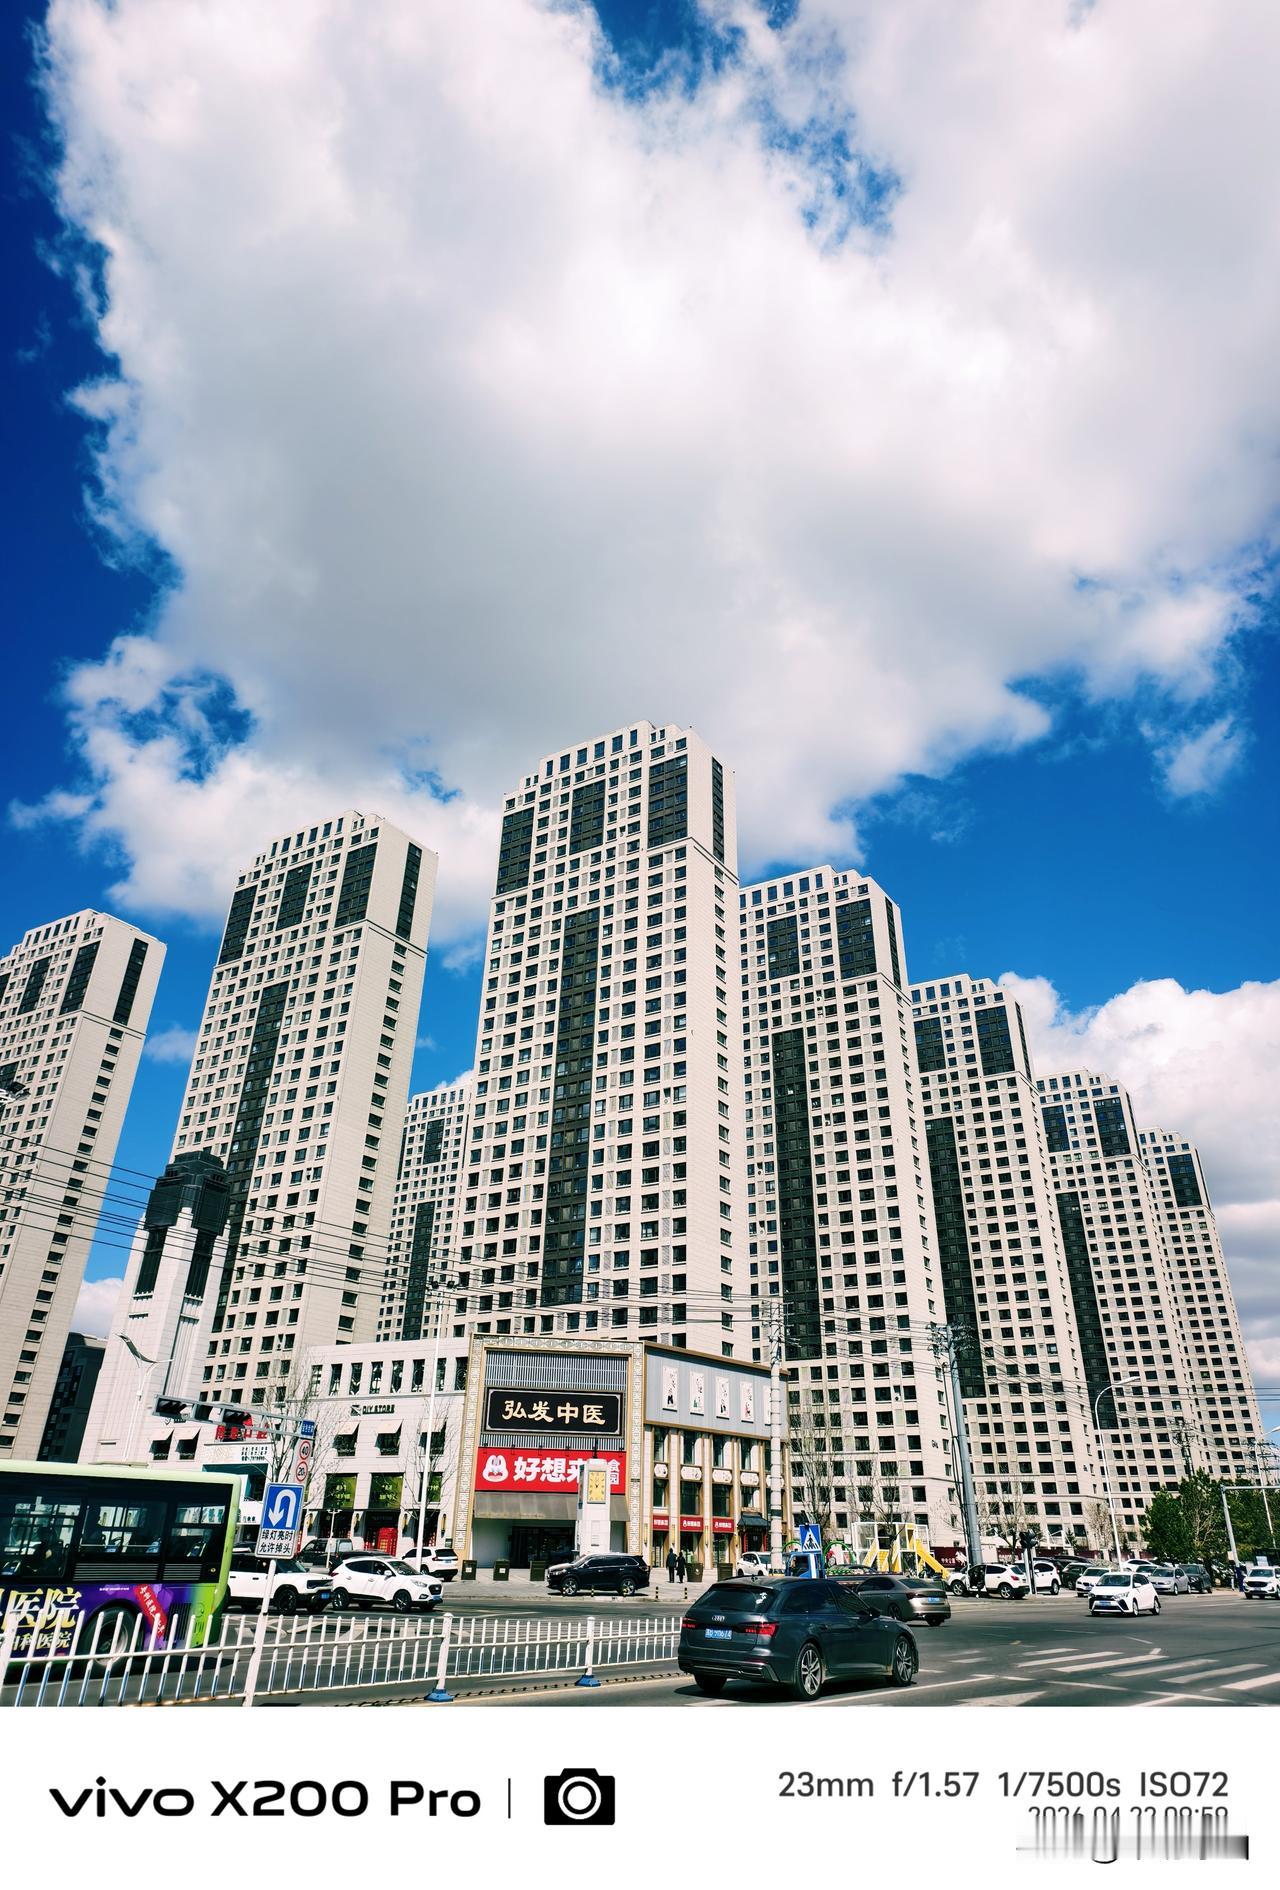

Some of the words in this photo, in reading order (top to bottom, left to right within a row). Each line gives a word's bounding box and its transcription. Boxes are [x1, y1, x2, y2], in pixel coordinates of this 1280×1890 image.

[501, 1399, 606, 1426] 弘发中医
[301, 1446, 309, 1455] 40
[261, 1529, 293, 1541] 绿灯亮时
[260, 1542, 291, 1553] 允许掉头
[0, 1587, 82, 1631] 医院
